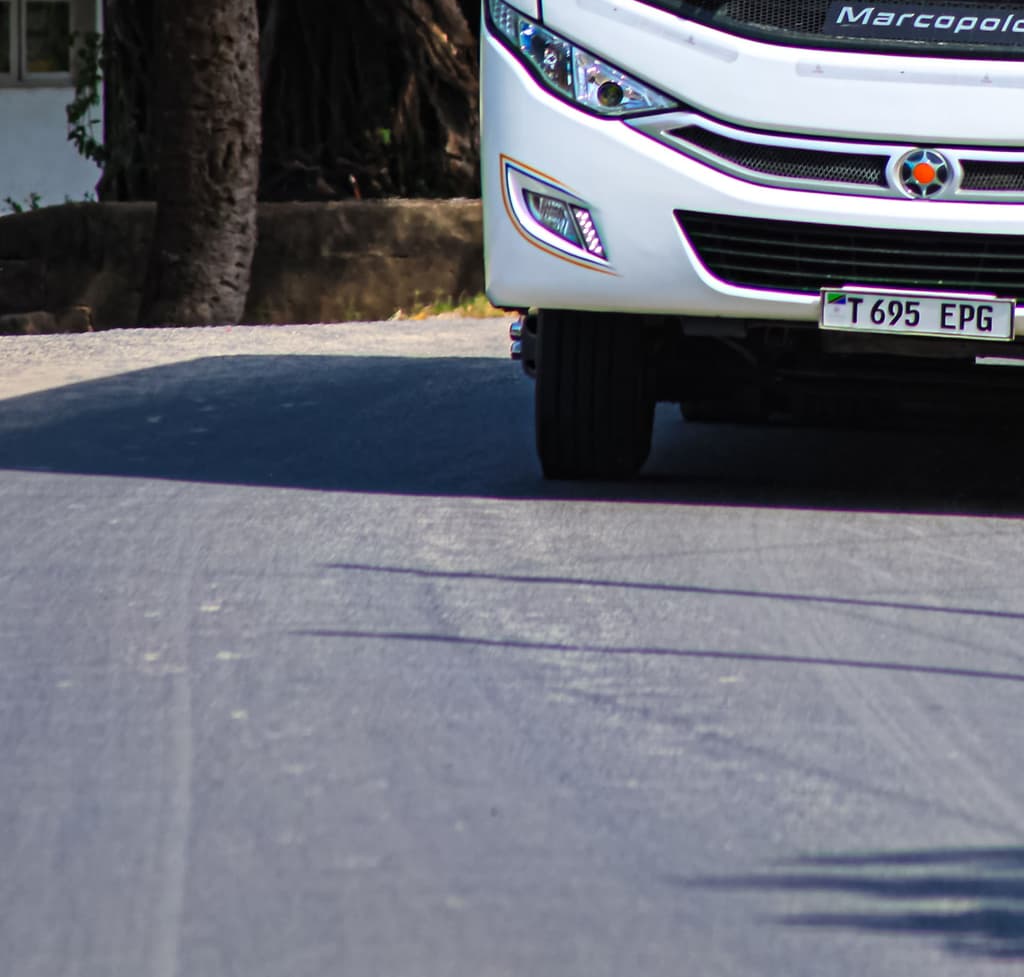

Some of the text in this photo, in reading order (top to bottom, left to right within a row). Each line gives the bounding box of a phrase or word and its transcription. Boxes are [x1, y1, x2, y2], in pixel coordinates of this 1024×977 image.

[848, 297, 993, 332] T 695 EPG
